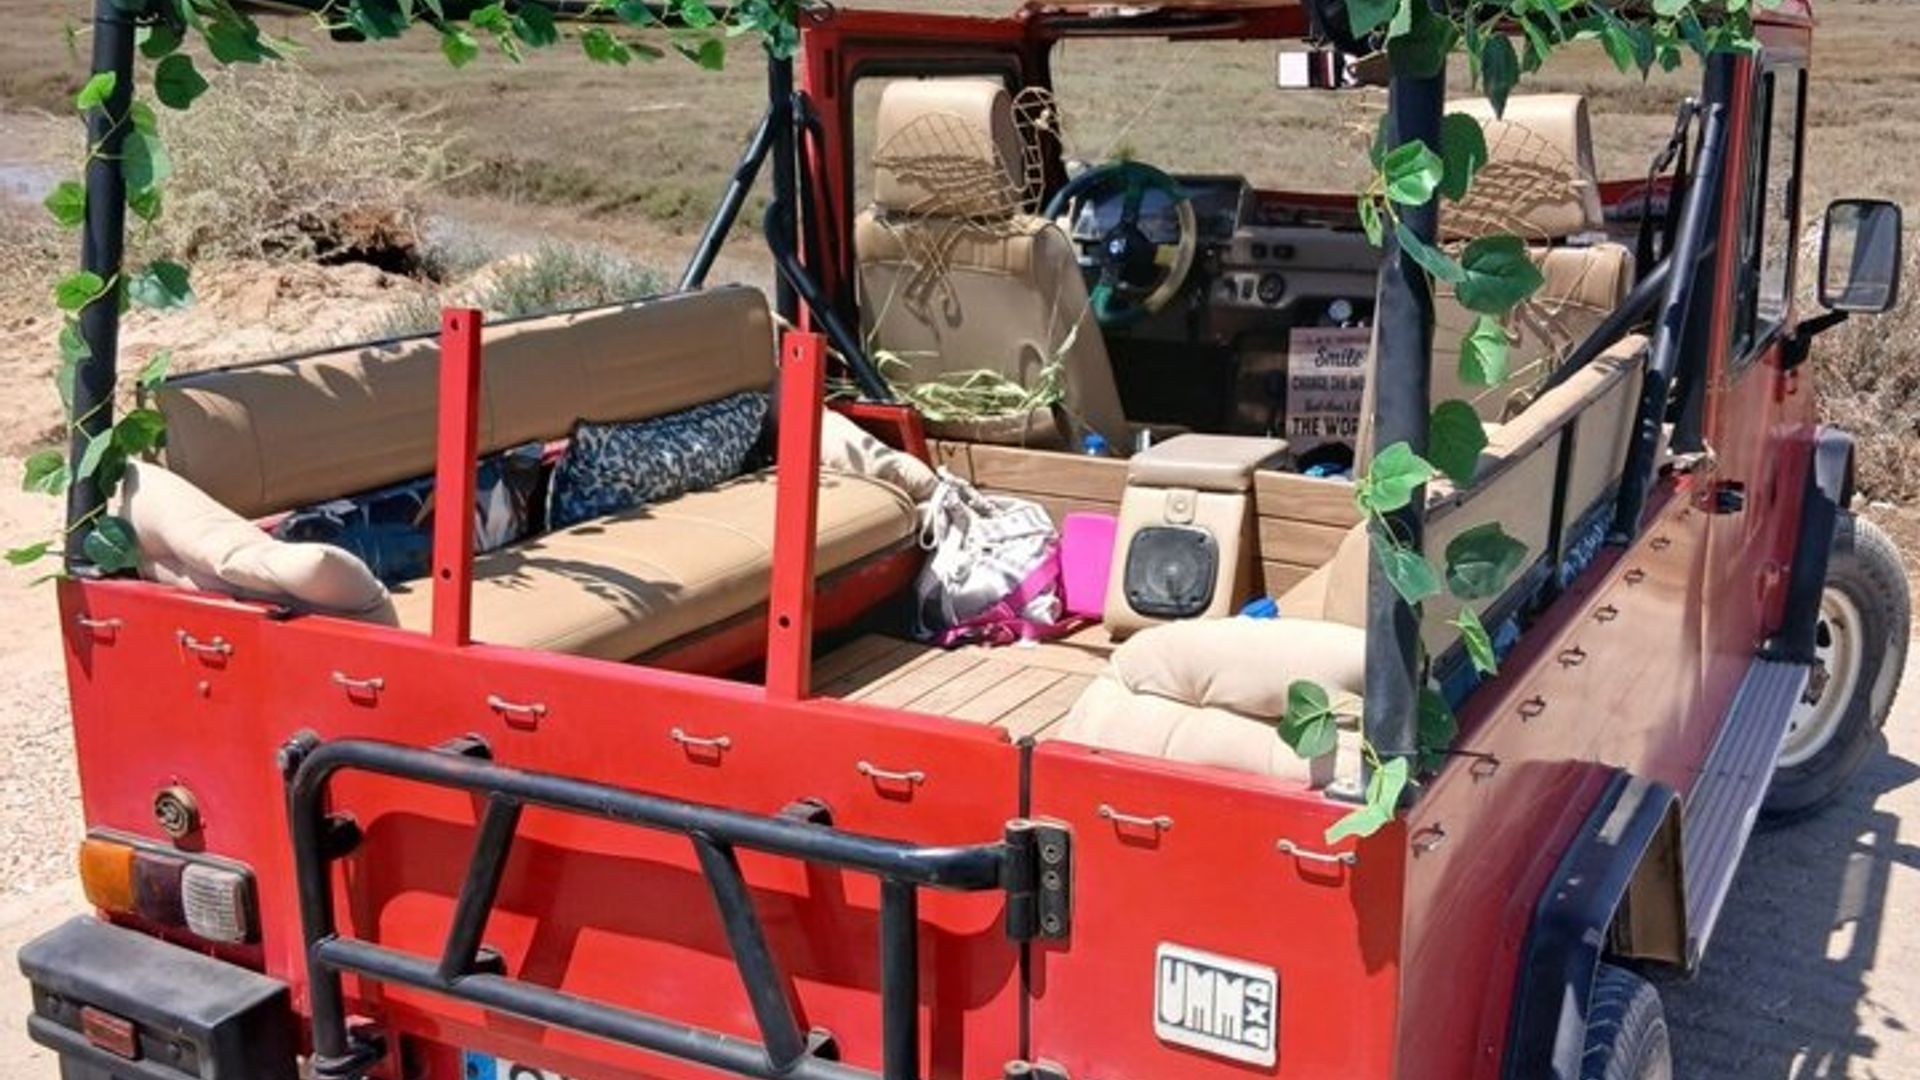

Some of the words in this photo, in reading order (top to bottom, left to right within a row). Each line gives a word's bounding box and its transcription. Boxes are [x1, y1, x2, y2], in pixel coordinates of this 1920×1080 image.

[1315, 346, 1364, 367] Smile
[1292, 416, 1320, 436] THE
[1322, 415, 1359, 437] WOR
[1161, 958, 1245, 1040] UMM
